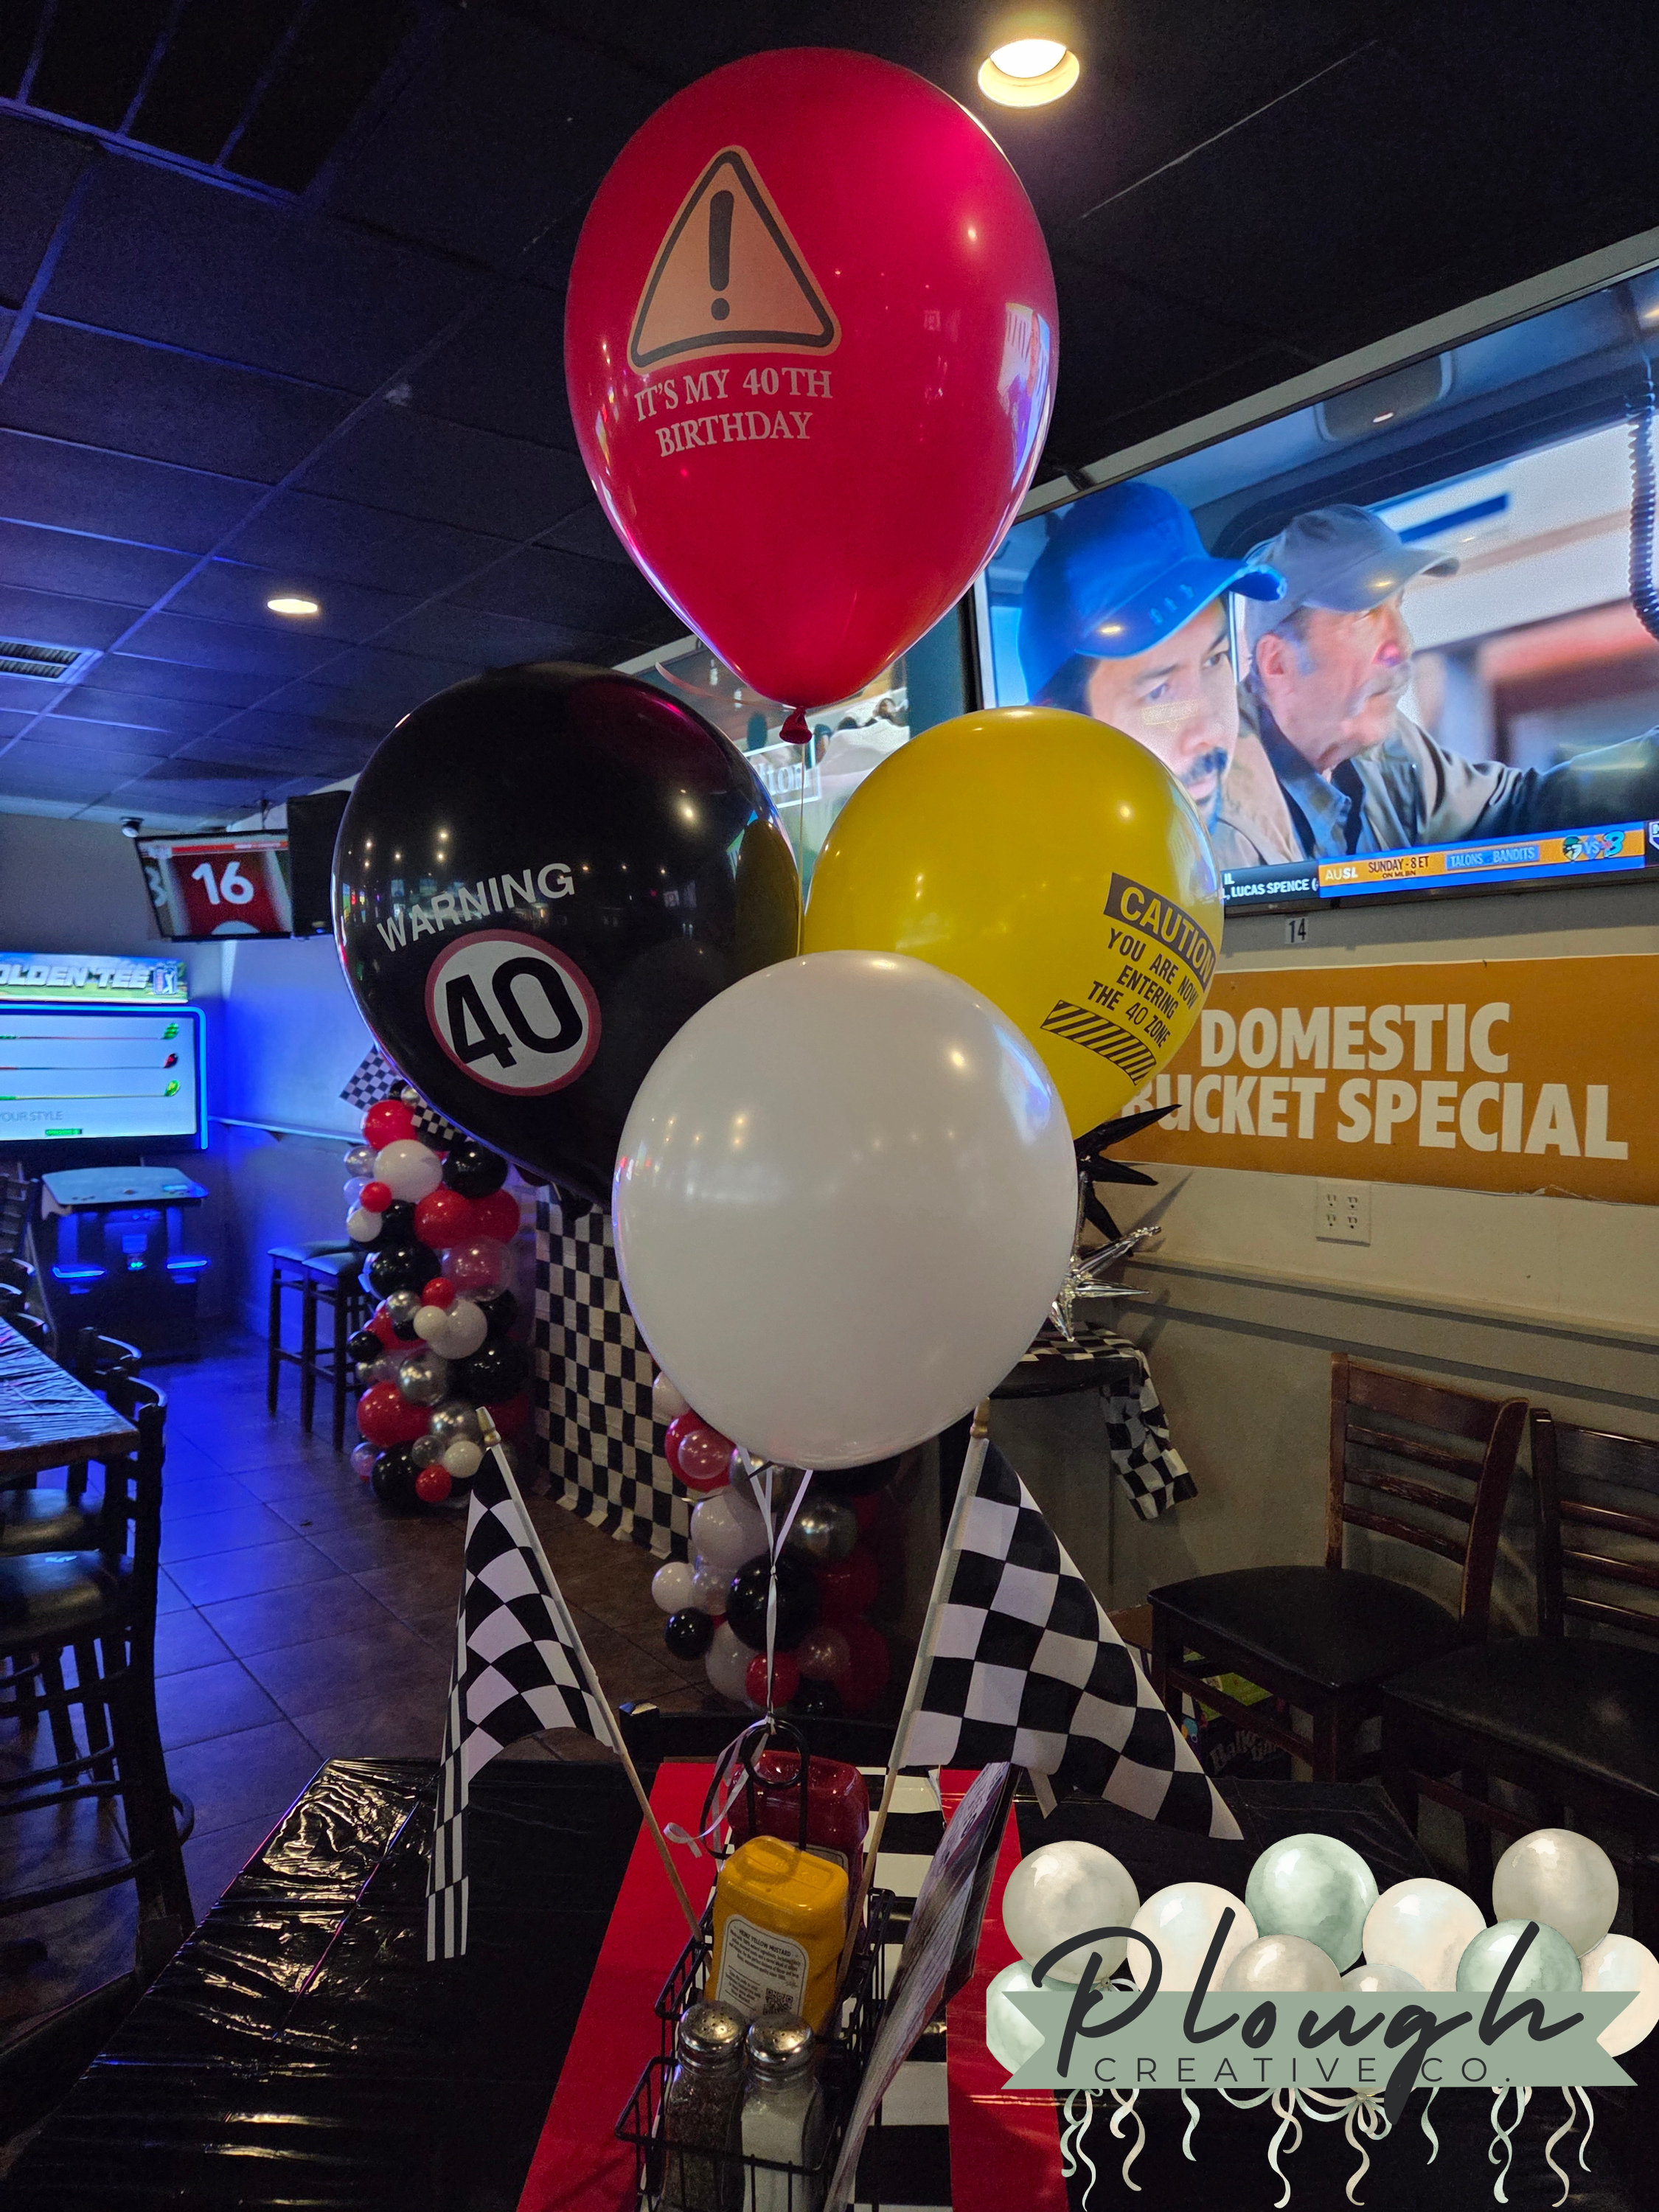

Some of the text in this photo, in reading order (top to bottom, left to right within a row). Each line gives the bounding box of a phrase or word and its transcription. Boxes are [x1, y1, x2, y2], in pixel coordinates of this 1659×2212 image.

[634, 368, 833, 422] IT'S MY 40TH
[655, 411, 813, 457] BIRTHDAY
[1325, 867, 1358, 880] AUSL
[1368, 858, 1404, 873] SUNDAY
[1411, 857, 1417, 869] 8
[1419, 855, 1430, 868] ET
[1450, 853, 1484, 867] TALONS
[1492, 846, 1535, 863] BANDITS
[191, 861, 254, 905] 16
[377, 863, 575, 952] WARNING
[1231, 883, 1266, 898] LUCAS
[1266, 879, 1310, 894] SPENCE
[1120, 886, 1215, 981] CAUTION
[1289, 918, 1306, 943] 14
[95, 967, 151, 990] TEE
[1107, 928, 1200, 1010] YOU ARE NOW
[1116, 964, 1179, 1020] ENTERING
[445, 956, 583, 1069] 40
[1088, 981, 1171, 1048] THE 40 ZONE
[1200, 1002, 1510, 1073] DOMESTIC
[0, 1110, 63, 1121] OUR STYLE
[1337, 1078, 1629, 1160] SPECIAL
[751, 1935, 768, 1949] YELLOW
[769, 1945, 792, 1958] MUSTARD
